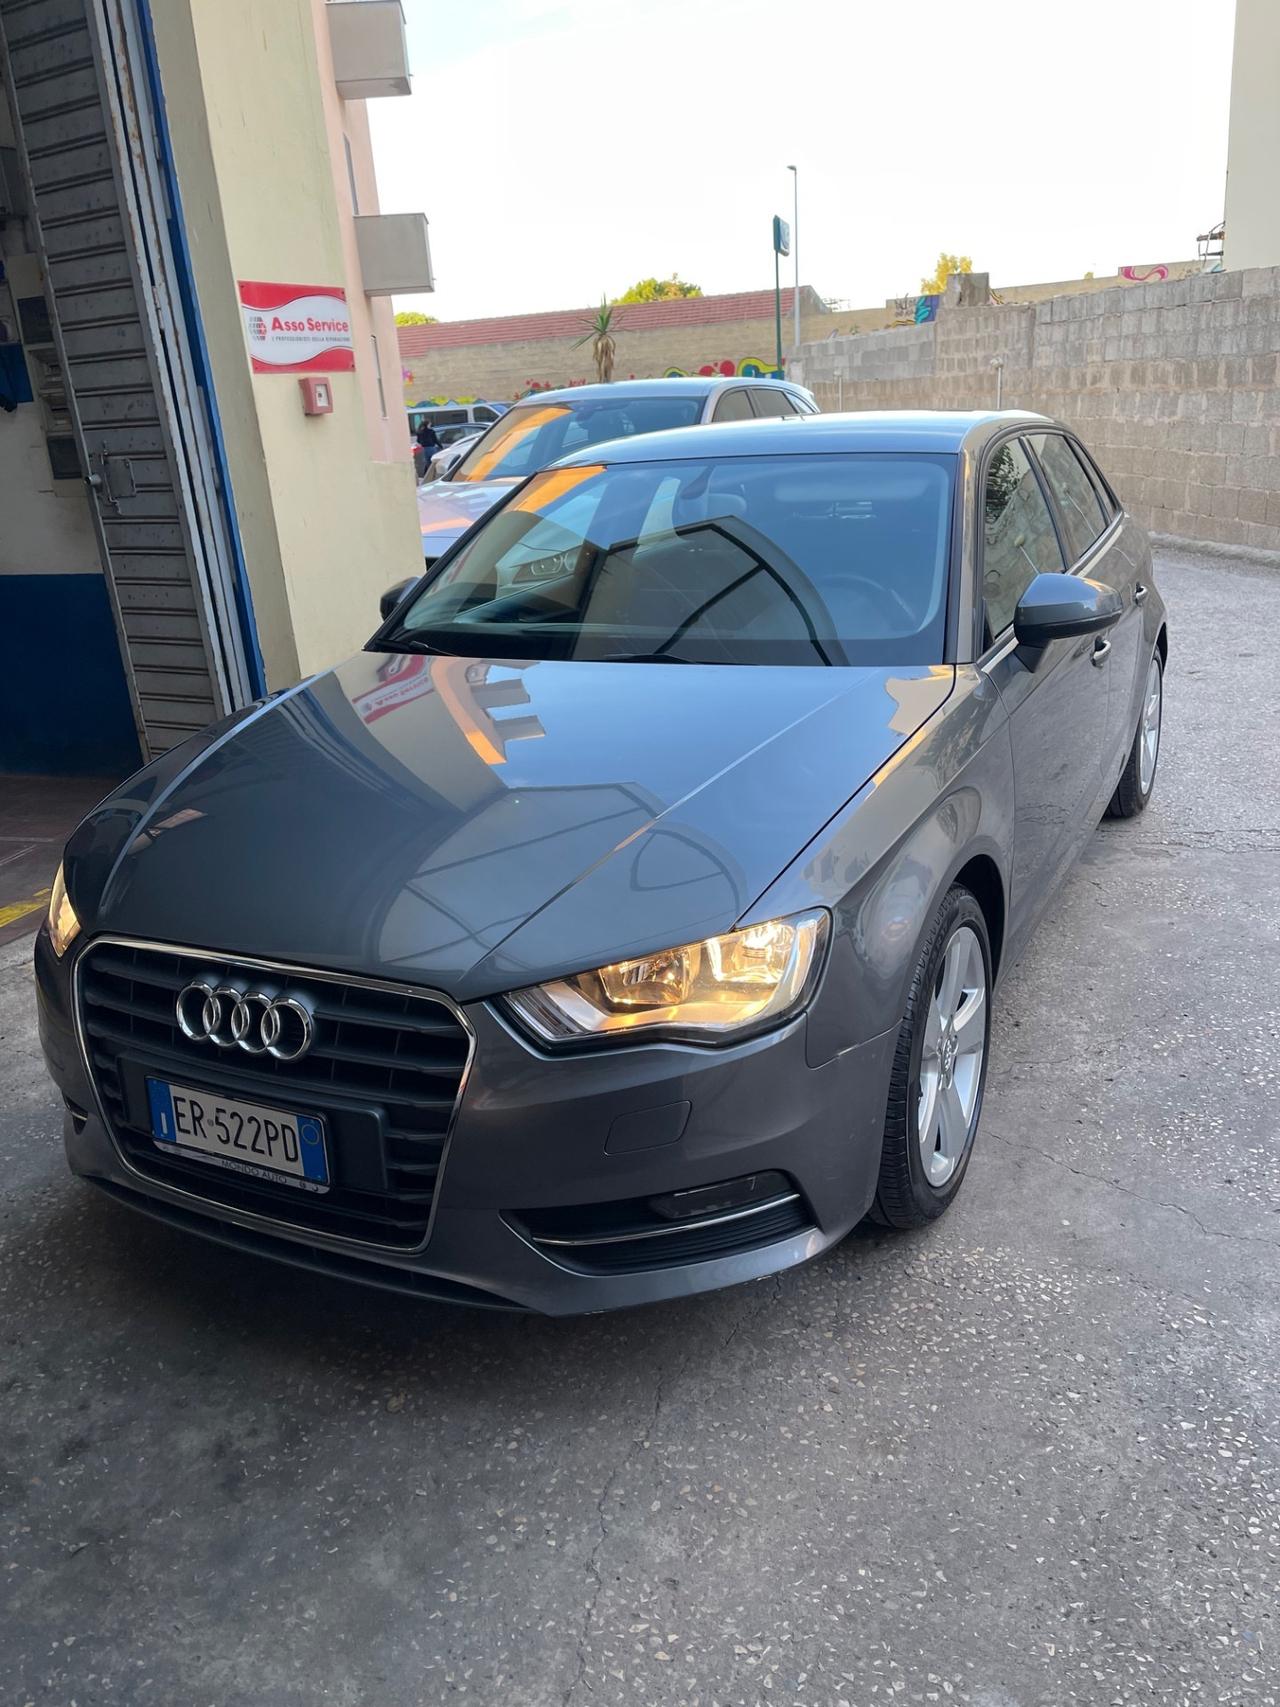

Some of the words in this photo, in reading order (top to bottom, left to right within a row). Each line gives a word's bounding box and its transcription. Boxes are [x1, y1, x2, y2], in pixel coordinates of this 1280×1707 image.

[272, 316, 304, 332] Asso
[307, 317, 349, 332] Service
[160, 1112, 168, 1135] I
[173, 1096, 207, 1138] ER
[214, 1108, 299, 1162] 522PD
[221, 1160, 260, 1176] MONDO
[262, 1172, 287, 1184] AUTO
